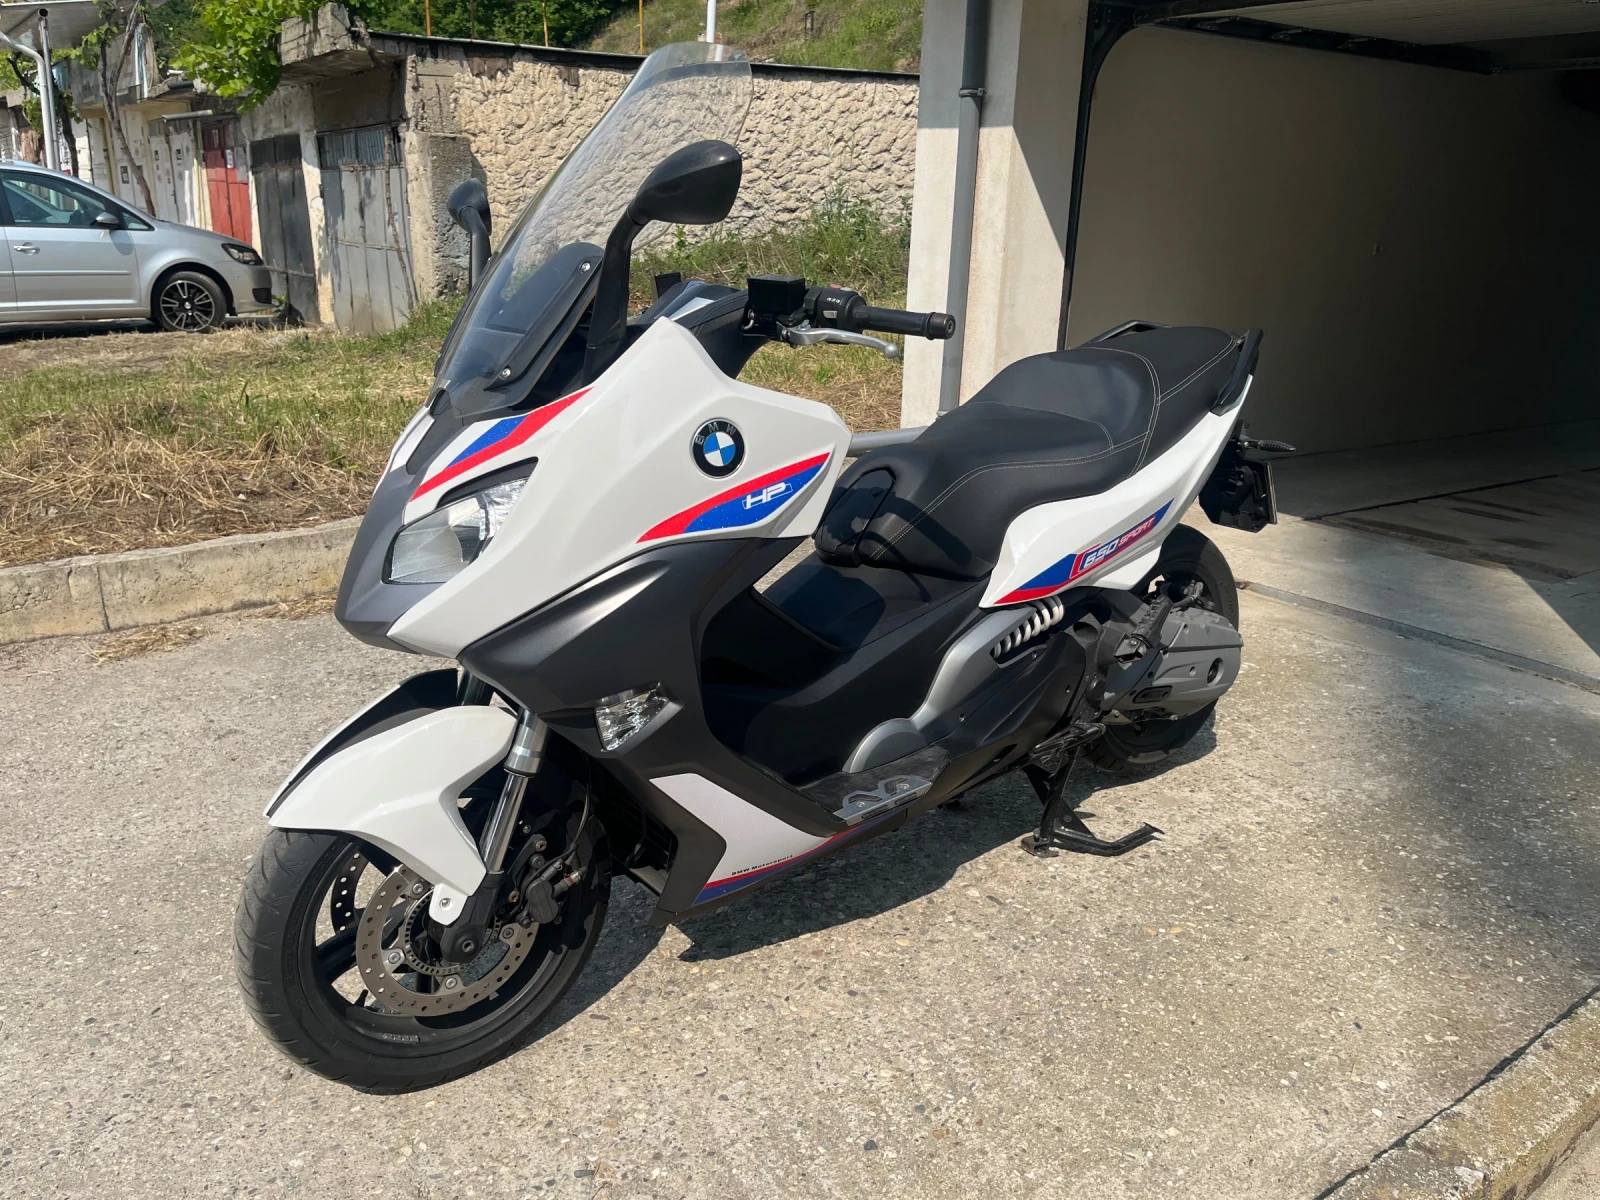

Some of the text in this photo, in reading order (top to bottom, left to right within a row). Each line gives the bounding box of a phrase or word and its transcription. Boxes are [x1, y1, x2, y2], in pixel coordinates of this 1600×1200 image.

[695, 421, 737, 446] BMW
[746, 482, 786, 509] HP
[1083, 516, 1157, 569] 650 SPORT
[731, 854, 793, 876] BMW Motorsport
